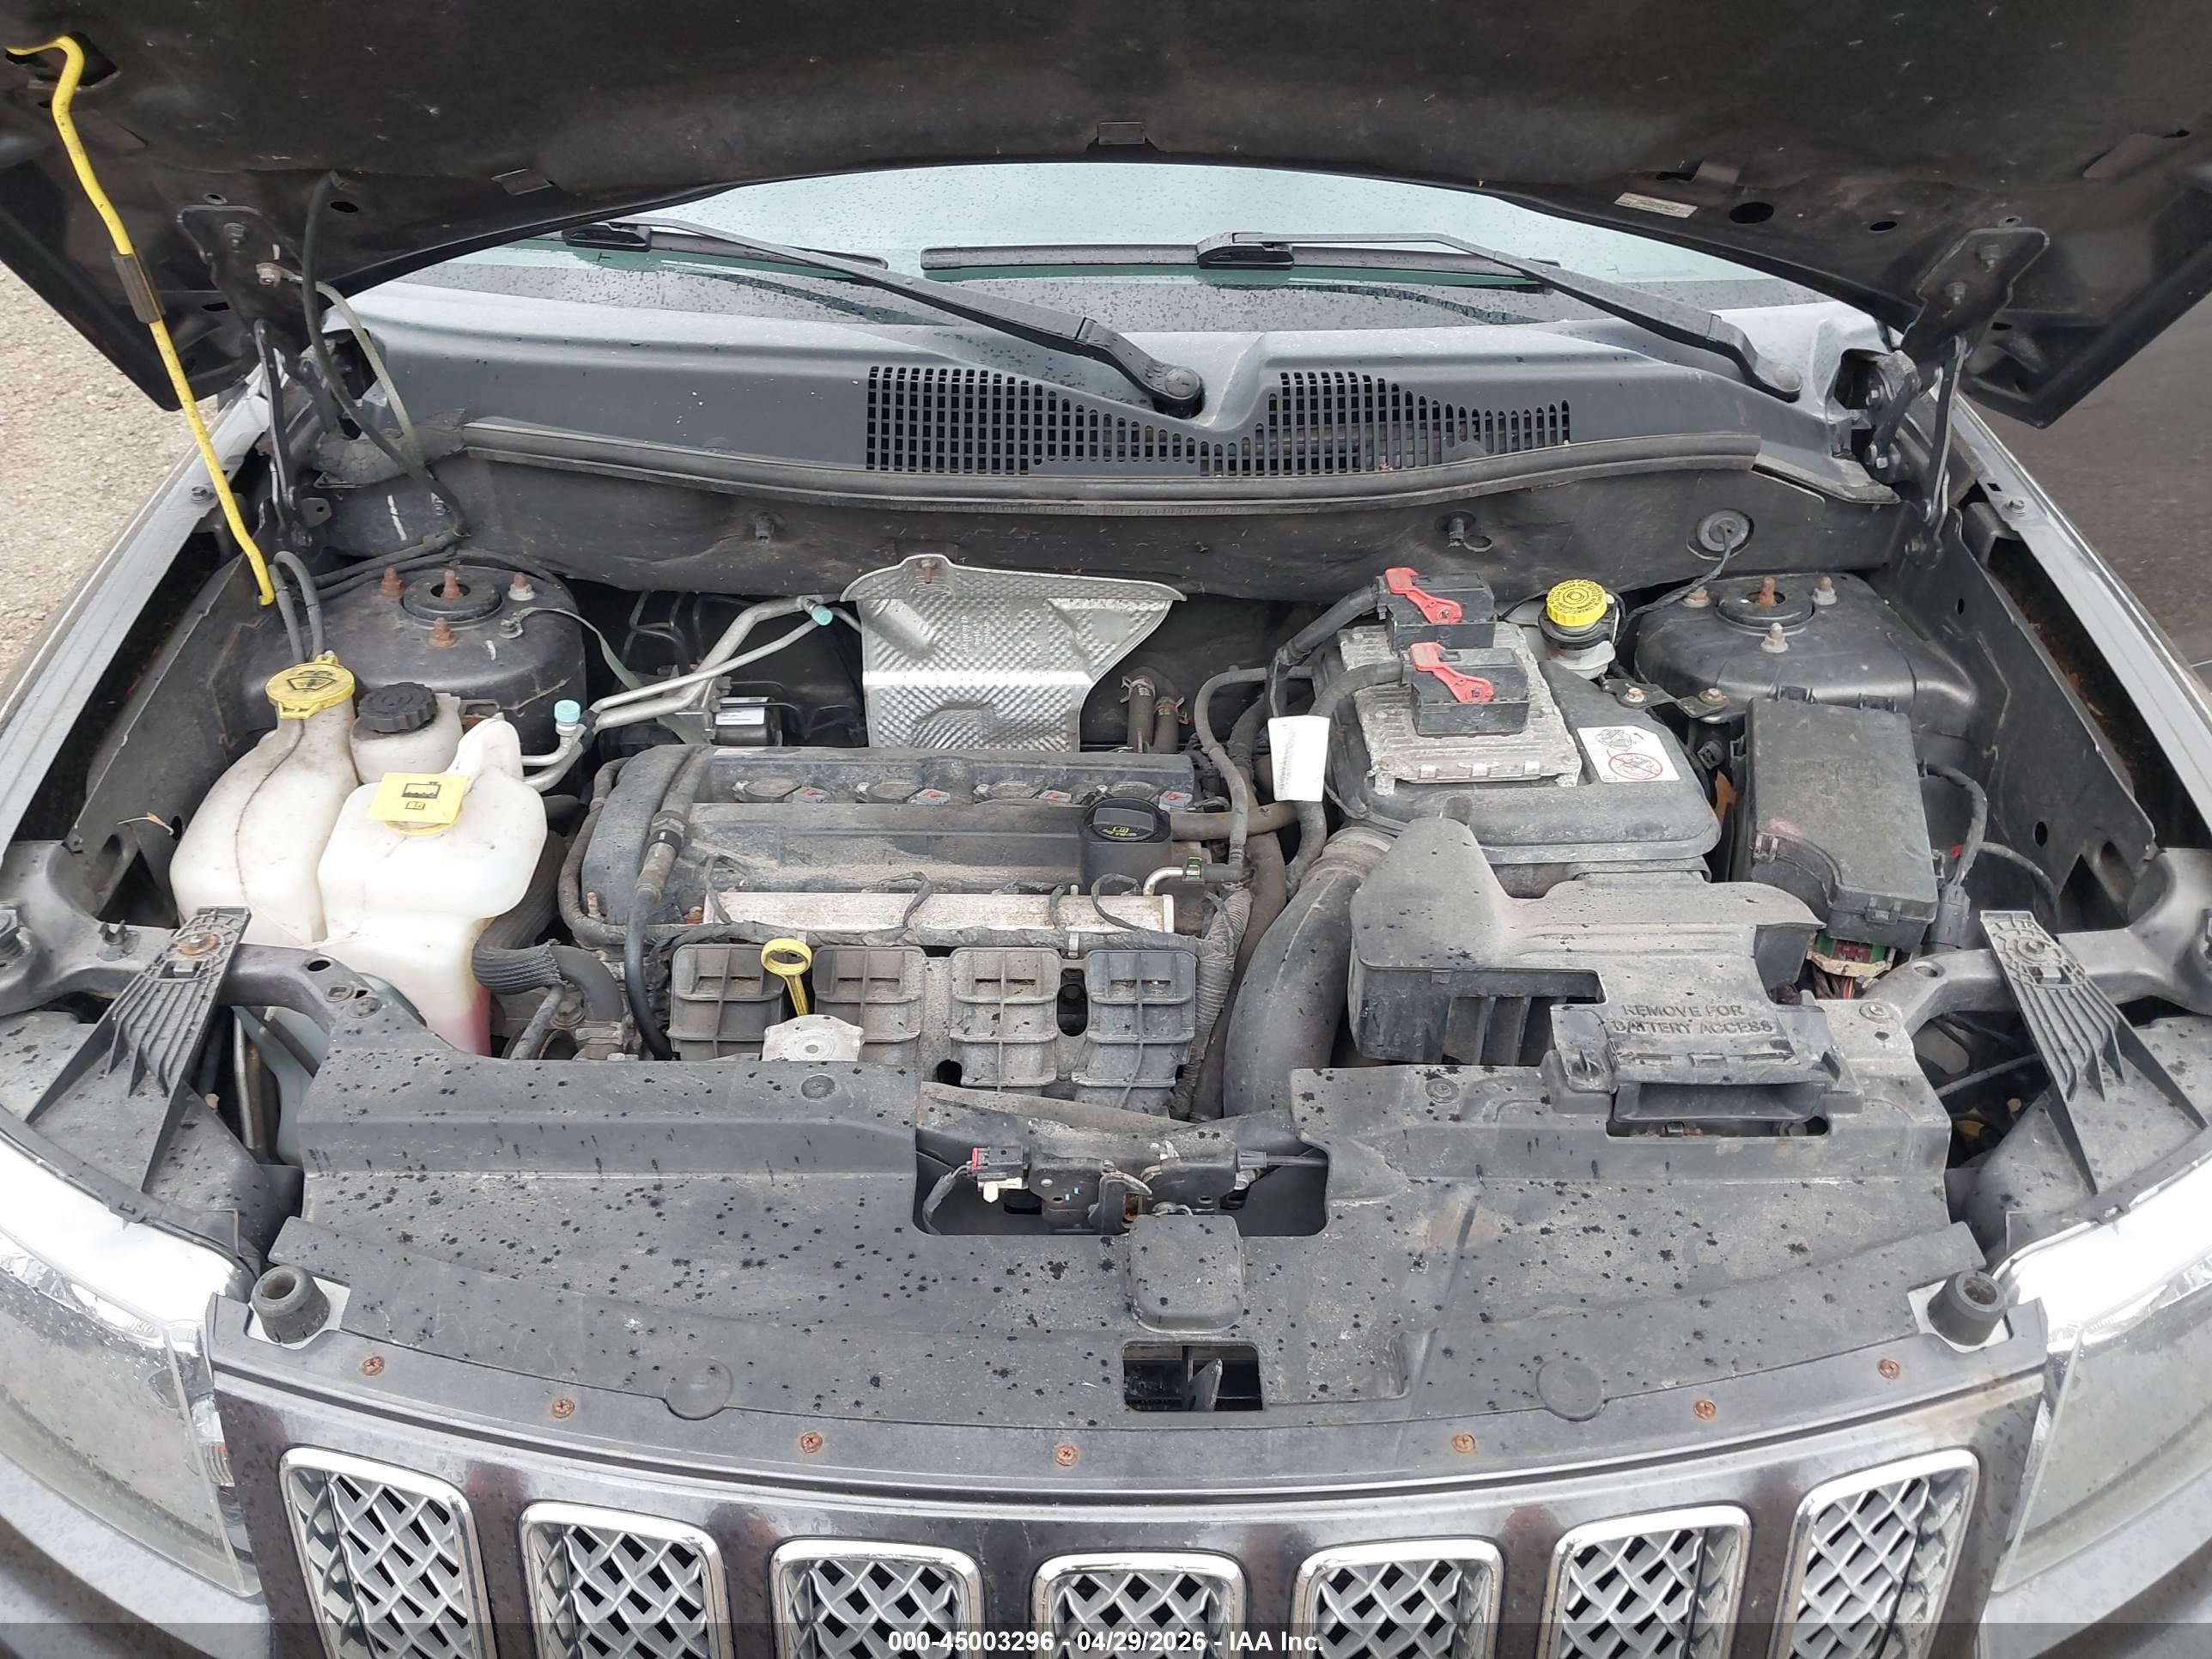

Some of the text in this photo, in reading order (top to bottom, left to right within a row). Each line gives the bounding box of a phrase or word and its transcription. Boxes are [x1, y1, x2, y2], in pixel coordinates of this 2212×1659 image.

[1622, 1004, 1746, 1018] REMOVE FOR
[1612, 1019, 1774, 1035] BATTERY ACCESS
